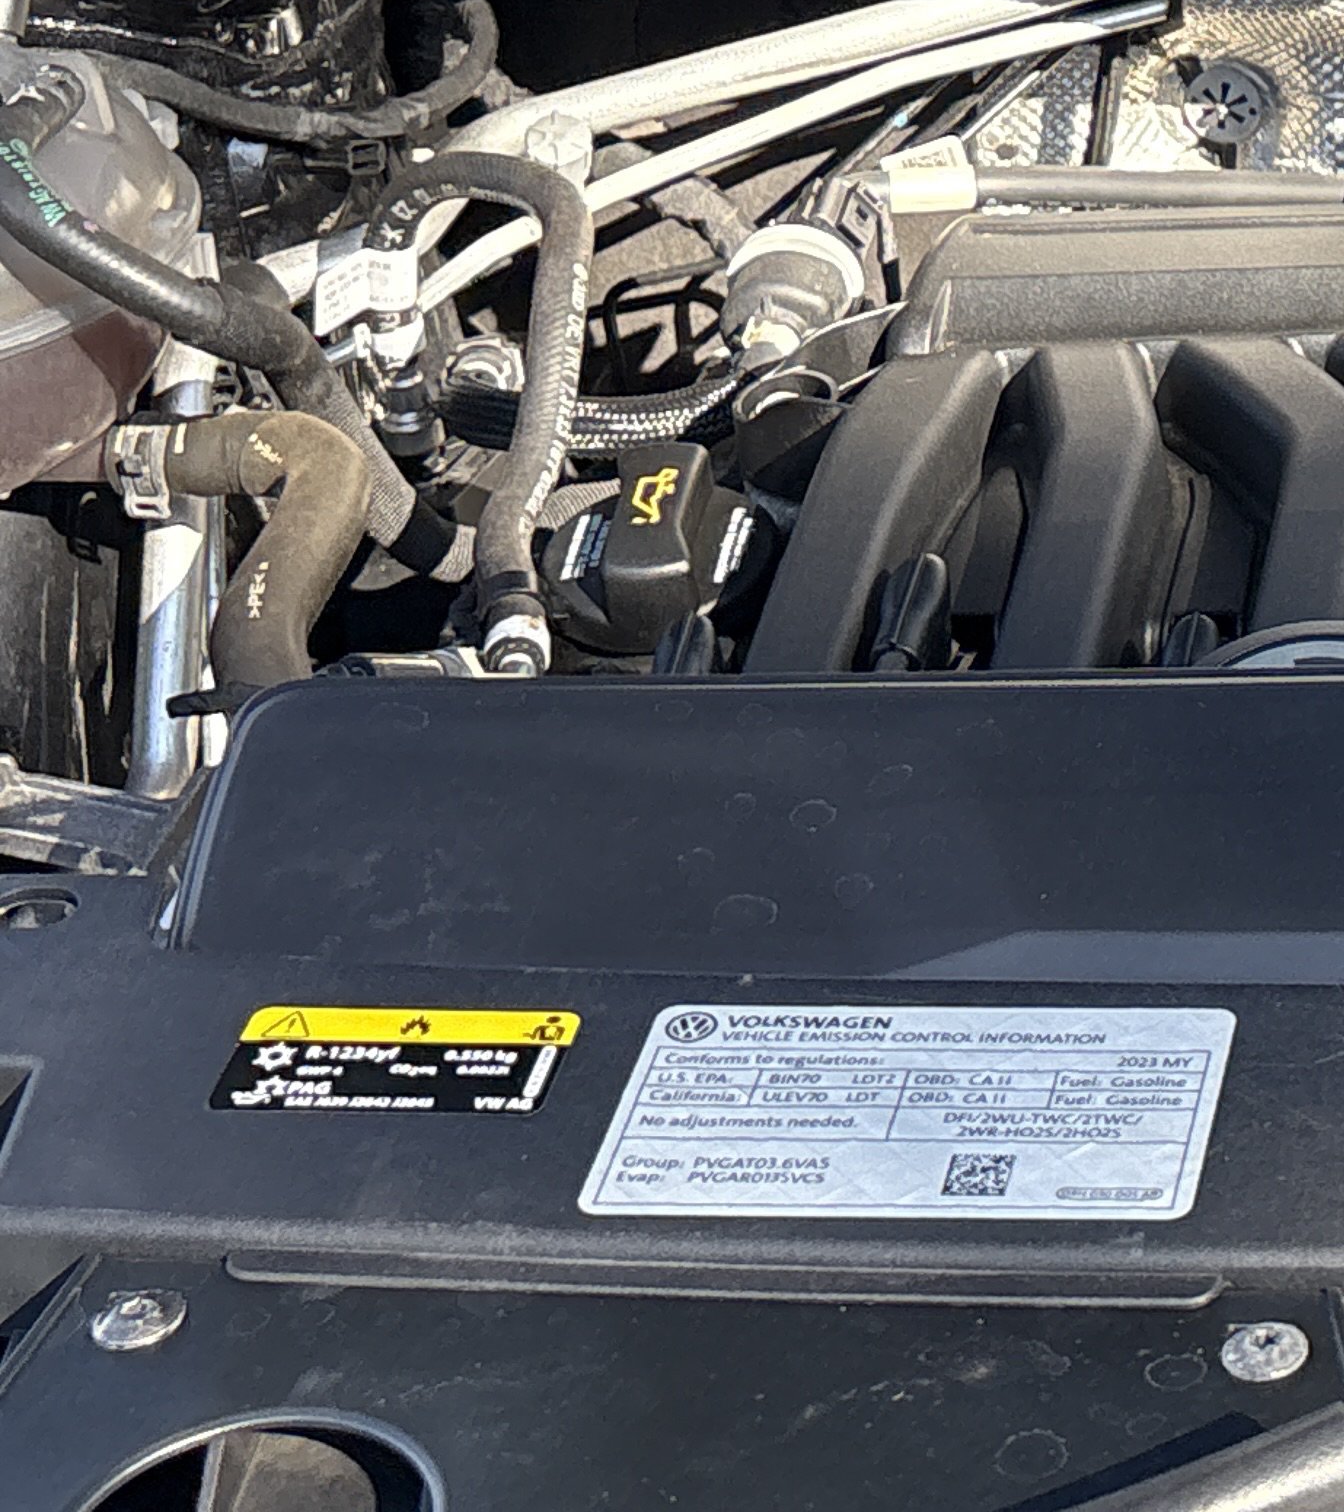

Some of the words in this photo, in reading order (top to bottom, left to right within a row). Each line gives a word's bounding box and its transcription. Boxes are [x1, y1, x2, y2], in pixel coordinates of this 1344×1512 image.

[728, 1015, 894, 1029] VOLKSWAGEN
[722, 1030, 794, 1042] VEHICLE
[799, 1030, 886, 1043] EMISSION
[892, 1031, 974, 1044] CONTROL
[979, 1032, 1107, 1044] INFORMATION
[305, 1045, 401, 1063] R-1234yf
[495, 1048, 518, 1064] kg
[664, 1052, 750, 1065] Conforms
[755, 1053, 774, 1064] to
[778, 1053, 885, 1068] regulations:
[1116, 1055, 1158, 1068] 2023
[1161, 1056, 1193, 1068] MY
[657, 1072, 690, 1084] U.S.
[768, 1074, 822, 1084] BIN70
[852, 1073, 897, 1084] LDT2
[914, 1074, 960, 1086] OBD:
[968, 1074, 994, 1086] CA
[1060, 1076, 1100, 1088] Fuel:
[1110, 1076, 1187, 1088] Gasoline
[287, 1080, 333, 1095] PAG
[649, 1089, 742, 1103] California:
[762, 1091, 829, 1103] ULEV70
[845, 1091, 880, 1103] LDT
[962, 1092, 988, 1104] CA
[1054, 1094, 1096, 1106] Fuel:
[1105, 1093, 1184, 1106] Gasoline
[474, 1096, 506, 1110] VW
[505, 1096, 534, 1111] AG
[638, 1115, 666, 1126] No
[668, 1114, 783, 1130] adjustments
[787, 1115, 858, 1128] needed.
[621, 1154, 685, 1170] Group:
[616, 1171, 665, 1185] Evap:
